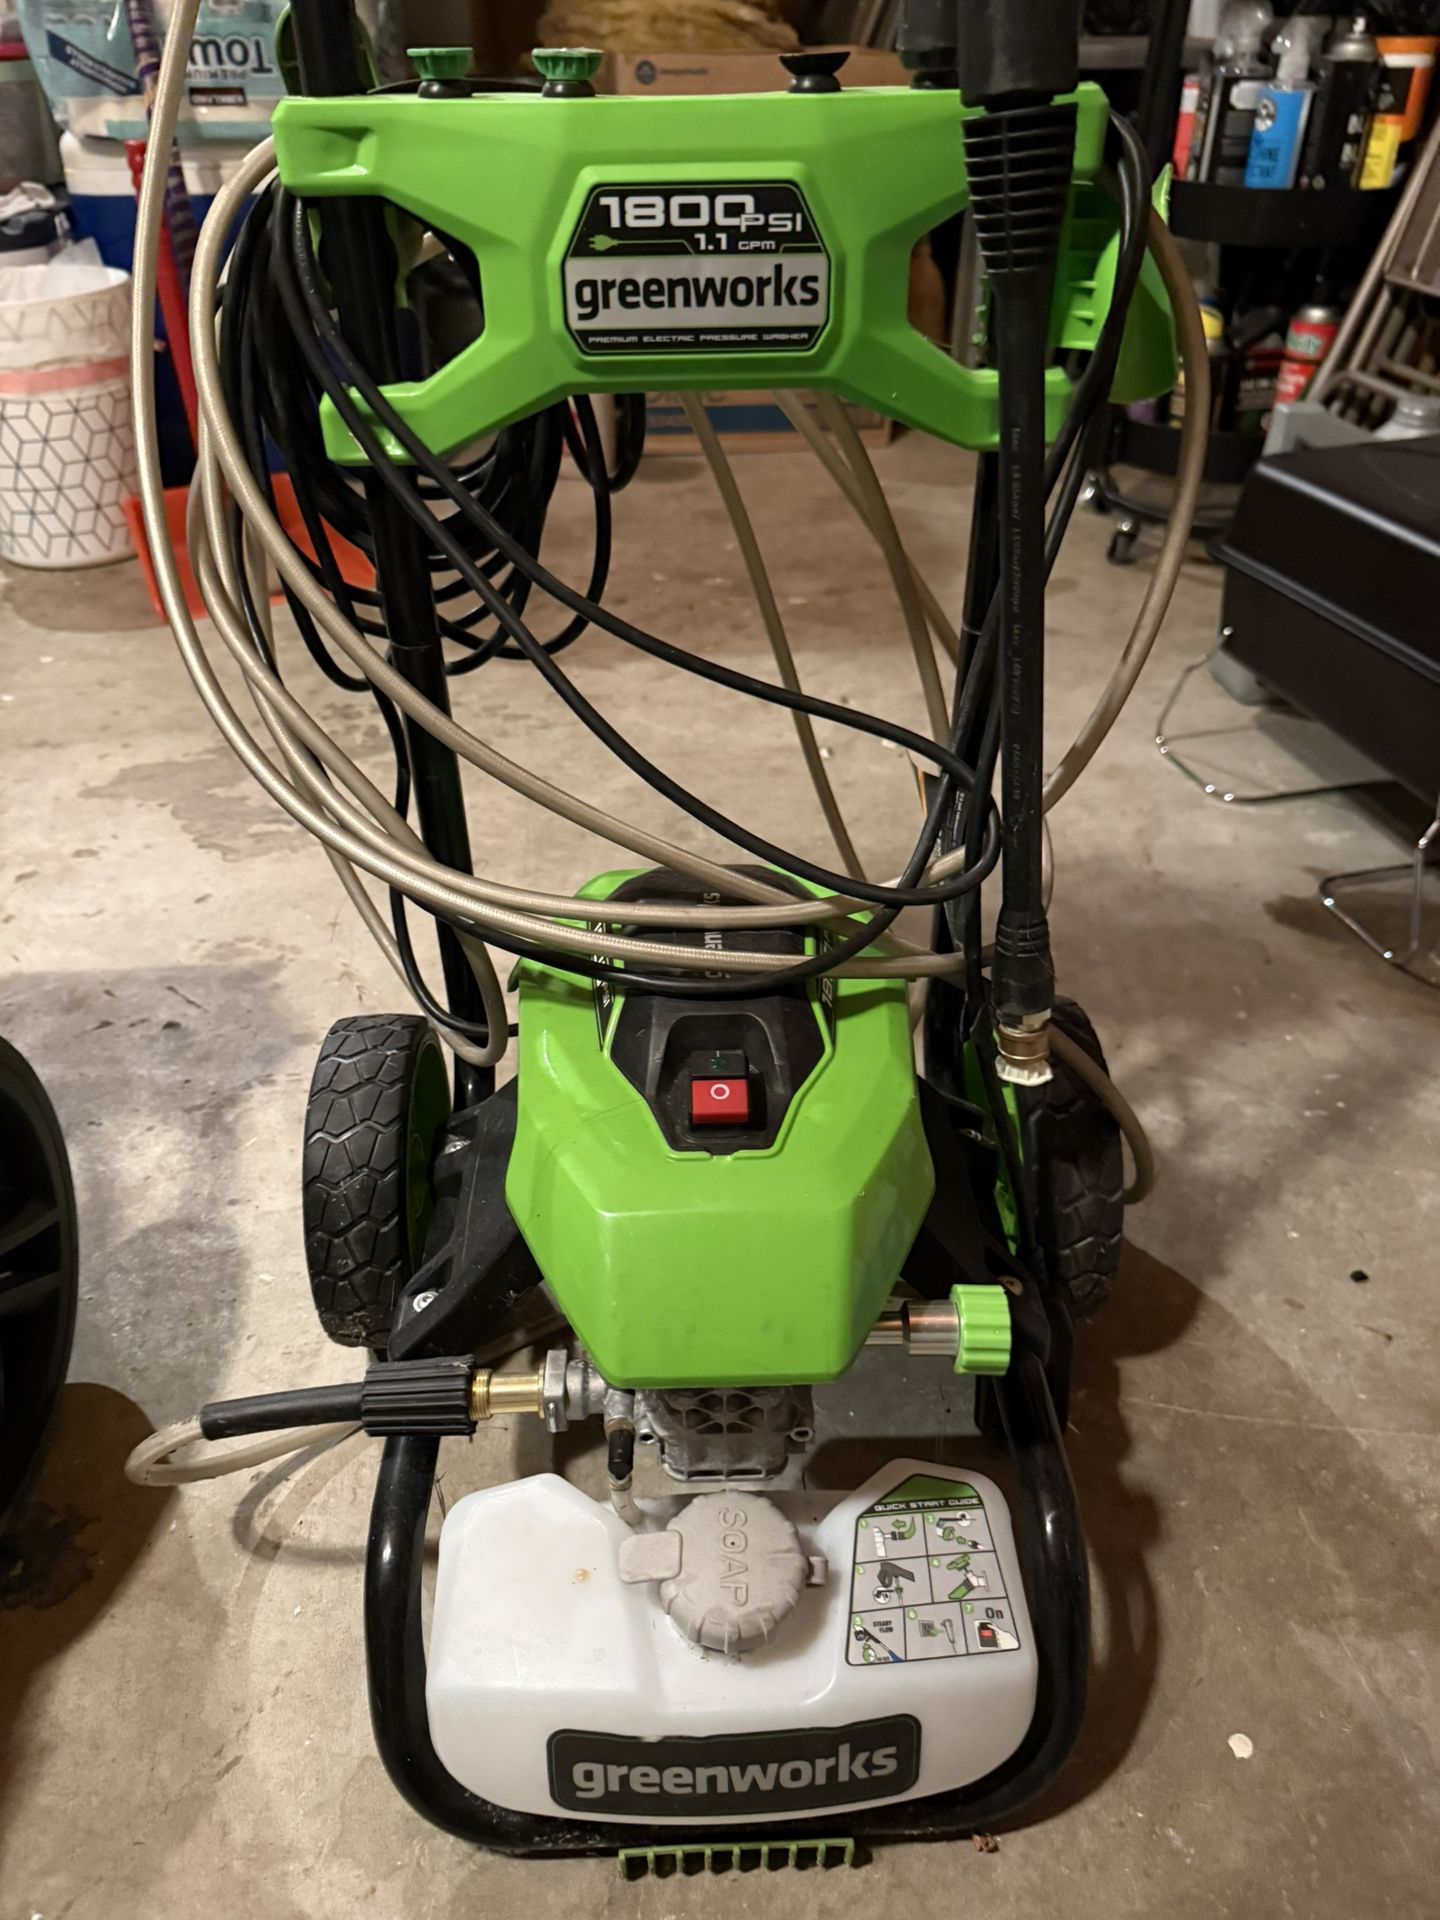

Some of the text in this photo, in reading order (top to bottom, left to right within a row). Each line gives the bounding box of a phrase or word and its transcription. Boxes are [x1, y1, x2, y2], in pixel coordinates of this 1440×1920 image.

[599, 194, 802, 233] 1800 PSI
[694, 232, 728, 251] 1.1
[574, 263, 820, 321] greenworks
[588, 332, 809, 344] PREMIUM ELECTRIC PRESSURE WASHER
[873, 1497, 980, 1512] QUICK START GUIDE
[718, 1507, 750, 1608] SOAP
[985, 1606, 1005, 1619] On
[572, 1742, 898, 1799] greenworks
